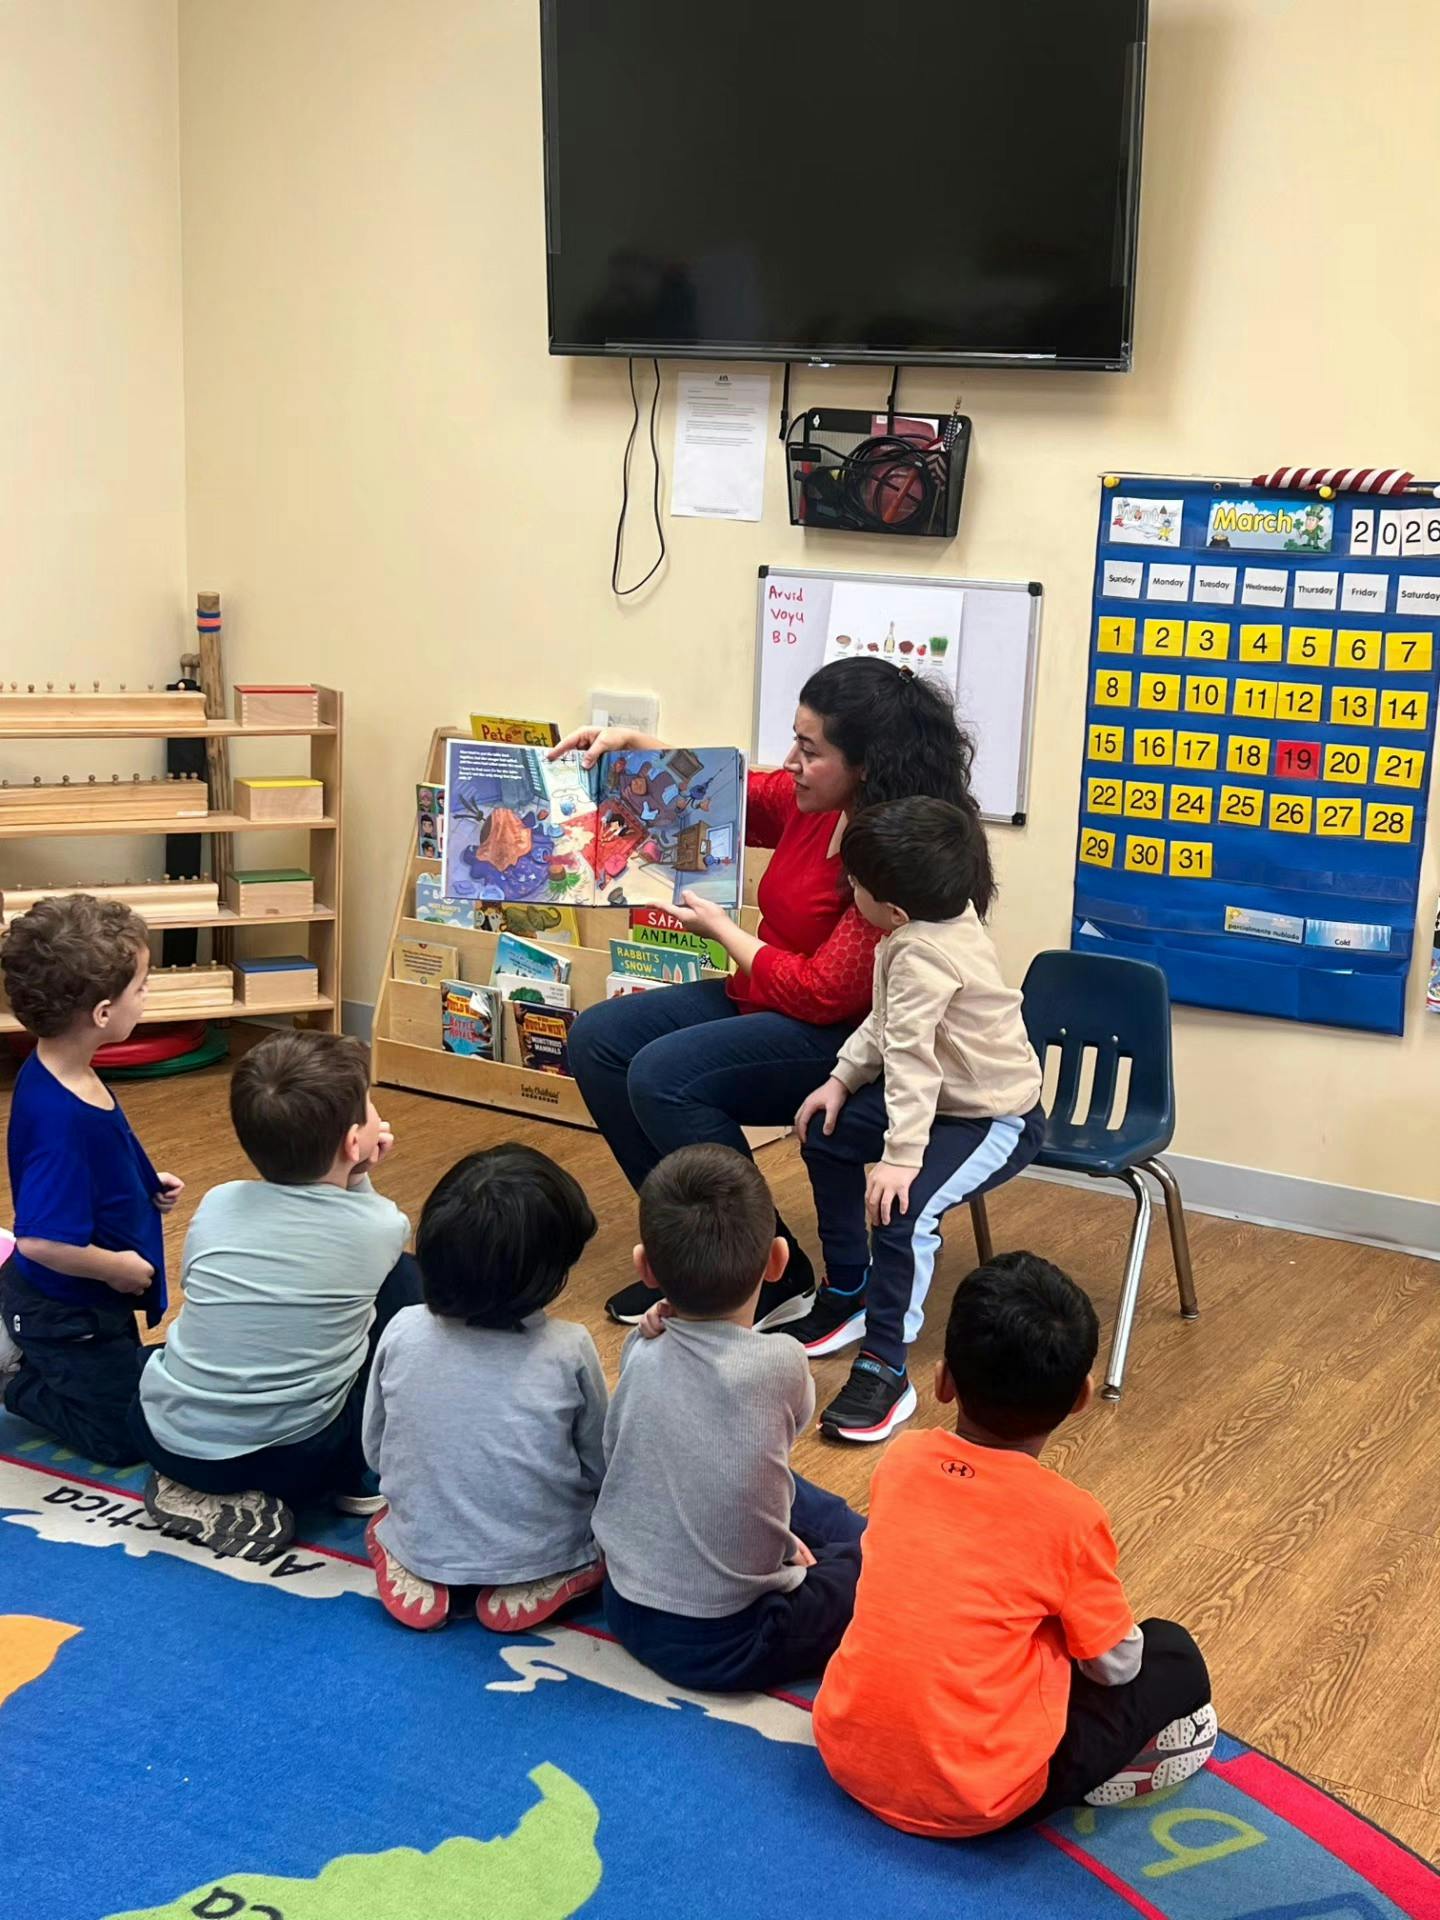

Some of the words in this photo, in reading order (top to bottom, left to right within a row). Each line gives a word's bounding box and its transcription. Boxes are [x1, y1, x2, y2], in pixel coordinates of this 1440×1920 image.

[1213, 507, 1293, 534] March
[768, 585, 804, 602] Arvid
[1108, 574, 1137, 586] Sunday
[1152, 577, 1184, 588] Monday
[1199, 579, 1230, 590] Tuesday
[1245, 582, 1285, 594] Wednesday
[1298, 585, 1335, 596] Thursday
[1351, 587, 1378, 598] Friday
[1401, 590, 1440, 602] Saturday
[1113, 625, 1121, 646] 1
[1155, 626, 1170, 648] 2
[1199, 629, 1214, 651] 3
[1252, 632, 1268, 654] 4
[1301, 636, 1316, 658] 5
[1351, 638, 1366, 661] 6
[1401, 641, 1417, 663] 7
[1106, 676, 1119, 698] 8
[1152, 681, 1167, 702] 9
[1192, 683, 1219, 706] 10
[1245, 687, 1266, 710] 11
[1286, 691, 1314, 713] 12
[1339, 695, 1367, 718] 13
[1388, 698, 1418, 721] 14
[481, 723, 513, 743] Pete
[524, 730, 548, 747] Cat
[1094, 732, 1116, 754] 15
[1140, 736, 1165, 758] 16
[1183, 740, 1211, 761] 17
[1235, 744, 1261, 767] 18
[1285, 749, 1312, 771] 19
[1329, 751, 1361, 775] 20
[1384, 754, 1413, 779] 21
[1092, 784, 1117, 807] 22
[1130, 788, 1157, 811] 23
[1176, 792, 1205, 815] 24
[1226, 793, 1255, 817] 25
[1275, 802, 1304, 825] 26
[1323, 805, 1354, 828] 27
[1372, 810, 1404, 834] 28
[1085, 836, 1109, 859] 29
[1131, 843, 1158, 866] 30
[1178, 848, 1203, 870] 31
[647, 911, 684, 929] SAFA
[640, 929, 708, 949] ANIMALS
[1272, 929, 1300, 941] nublado
[1334, 938, 1351, 946] Cold
[616, 946, 660, 963] RABBIT'S
[623, 961, 653, 973] SNOW
[42, 1486, 326, 1578] Anrctica
